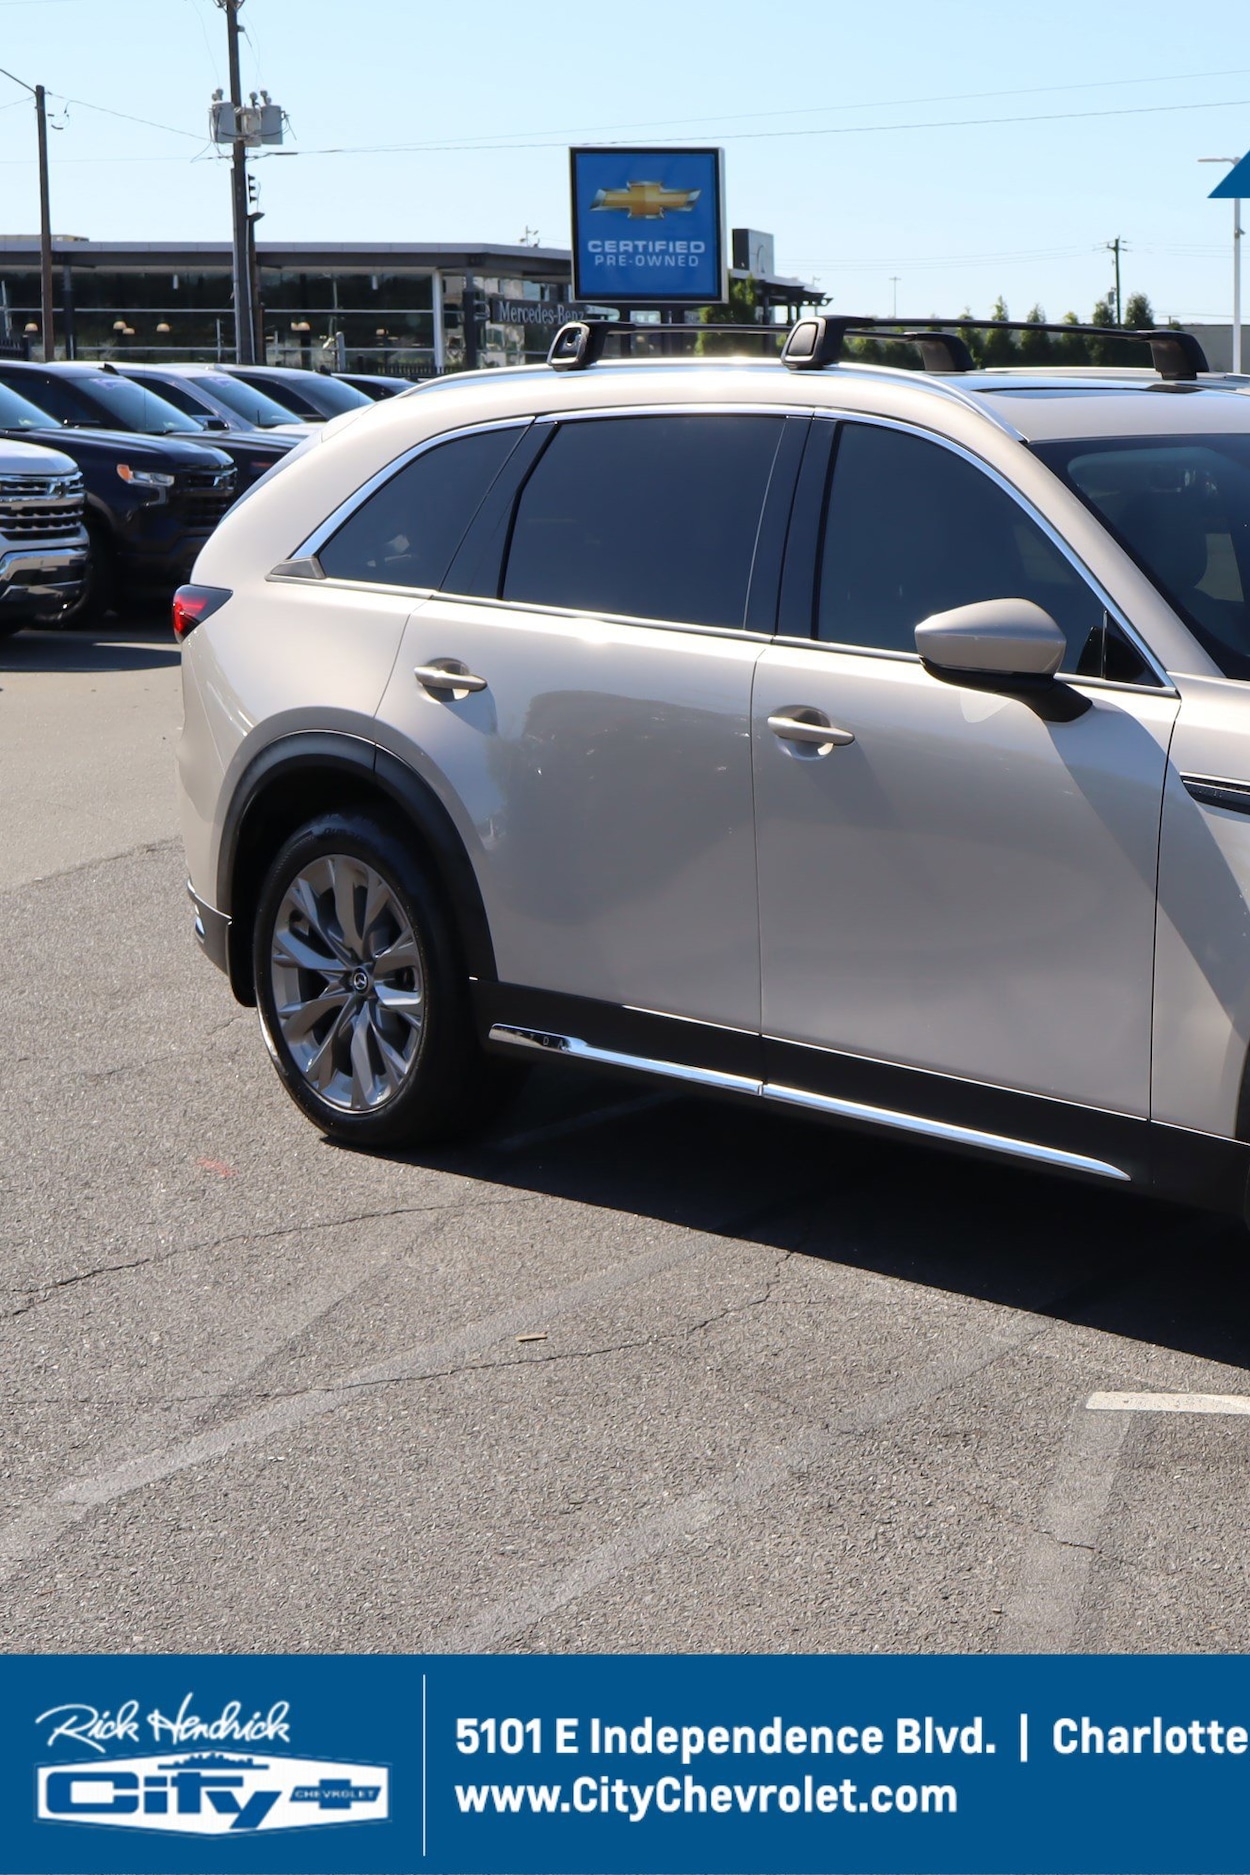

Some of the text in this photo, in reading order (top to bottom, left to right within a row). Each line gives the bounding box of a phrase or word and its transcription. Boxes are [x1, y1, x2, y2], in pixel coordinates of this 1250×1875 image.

[587, 240, 706, 253] CERTIFIED
[594, 254, 699, 267] PRE-OWNED
[498, 301, 585, 325] Mercedes-Benz
